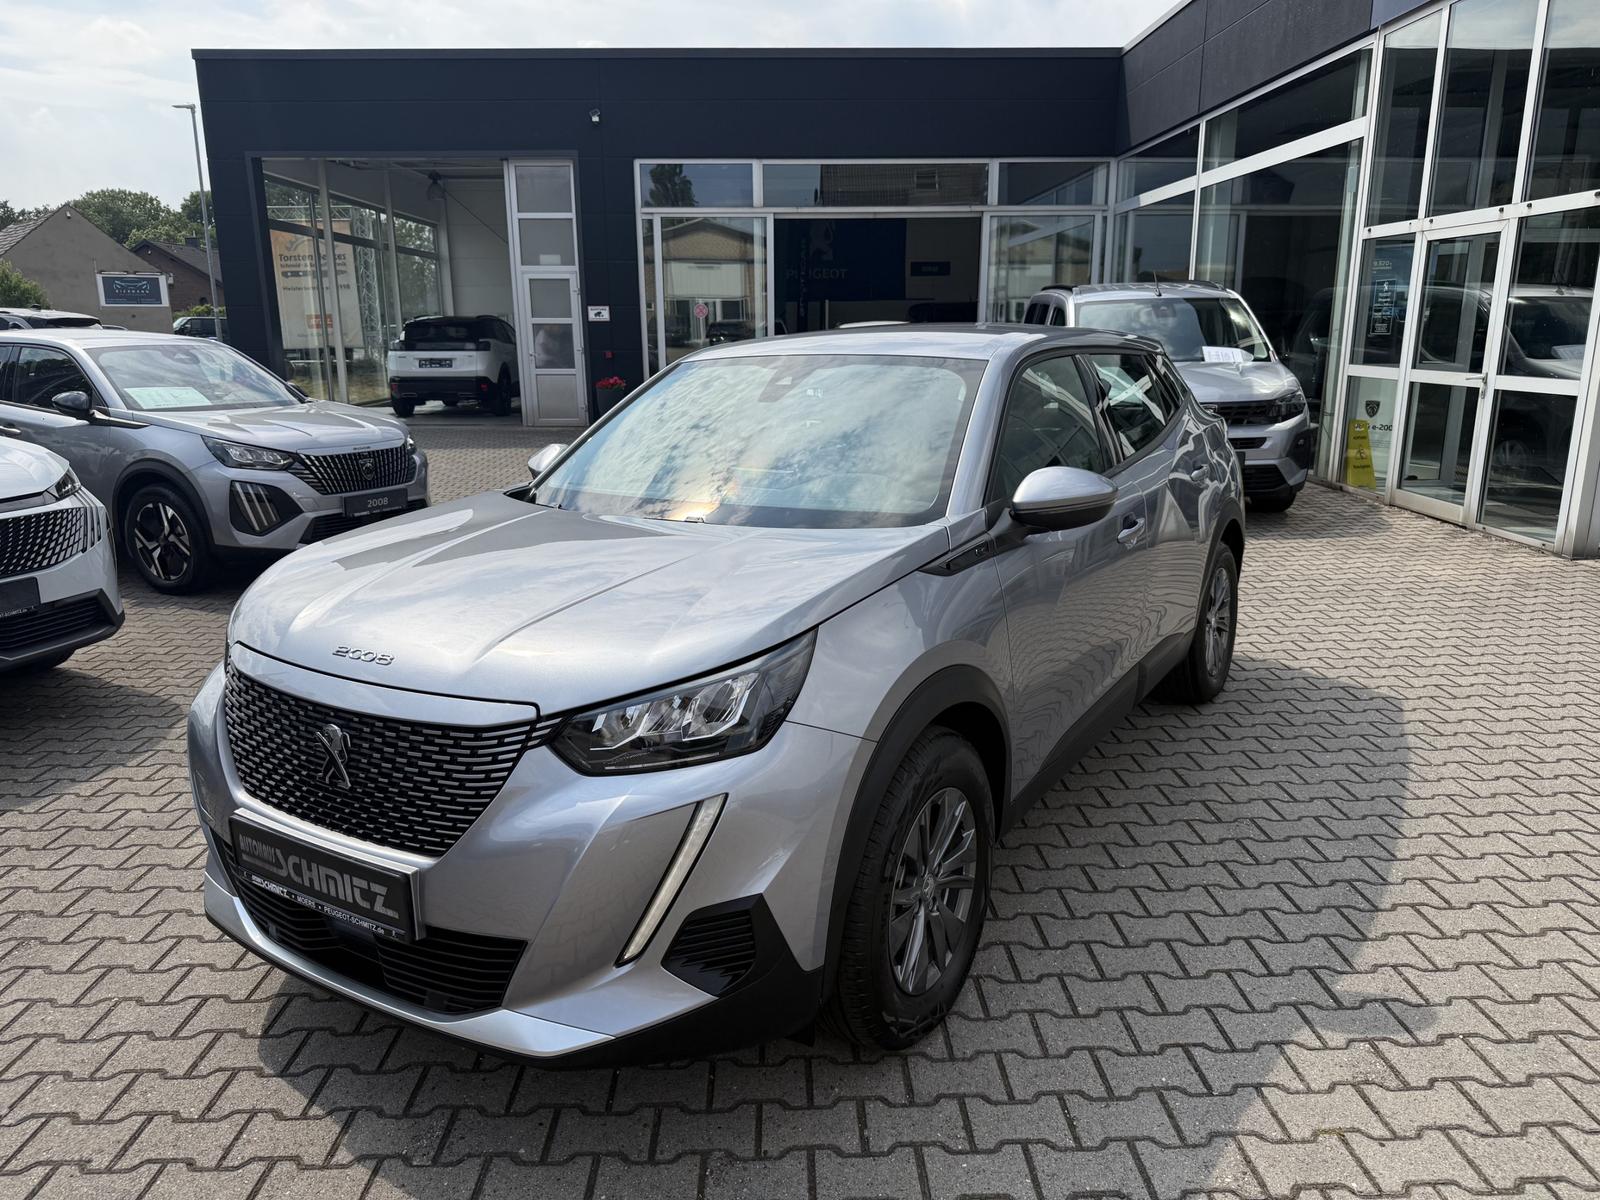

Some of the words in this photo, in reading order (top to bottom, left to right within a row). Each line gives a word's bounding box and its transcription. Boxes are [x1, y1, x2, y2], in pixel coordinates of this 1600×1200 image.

[367, 497, 389, 508] 2008
[332, 646, 395, 666] 2008
[275, 847, 400, 919] SCHMITZ
